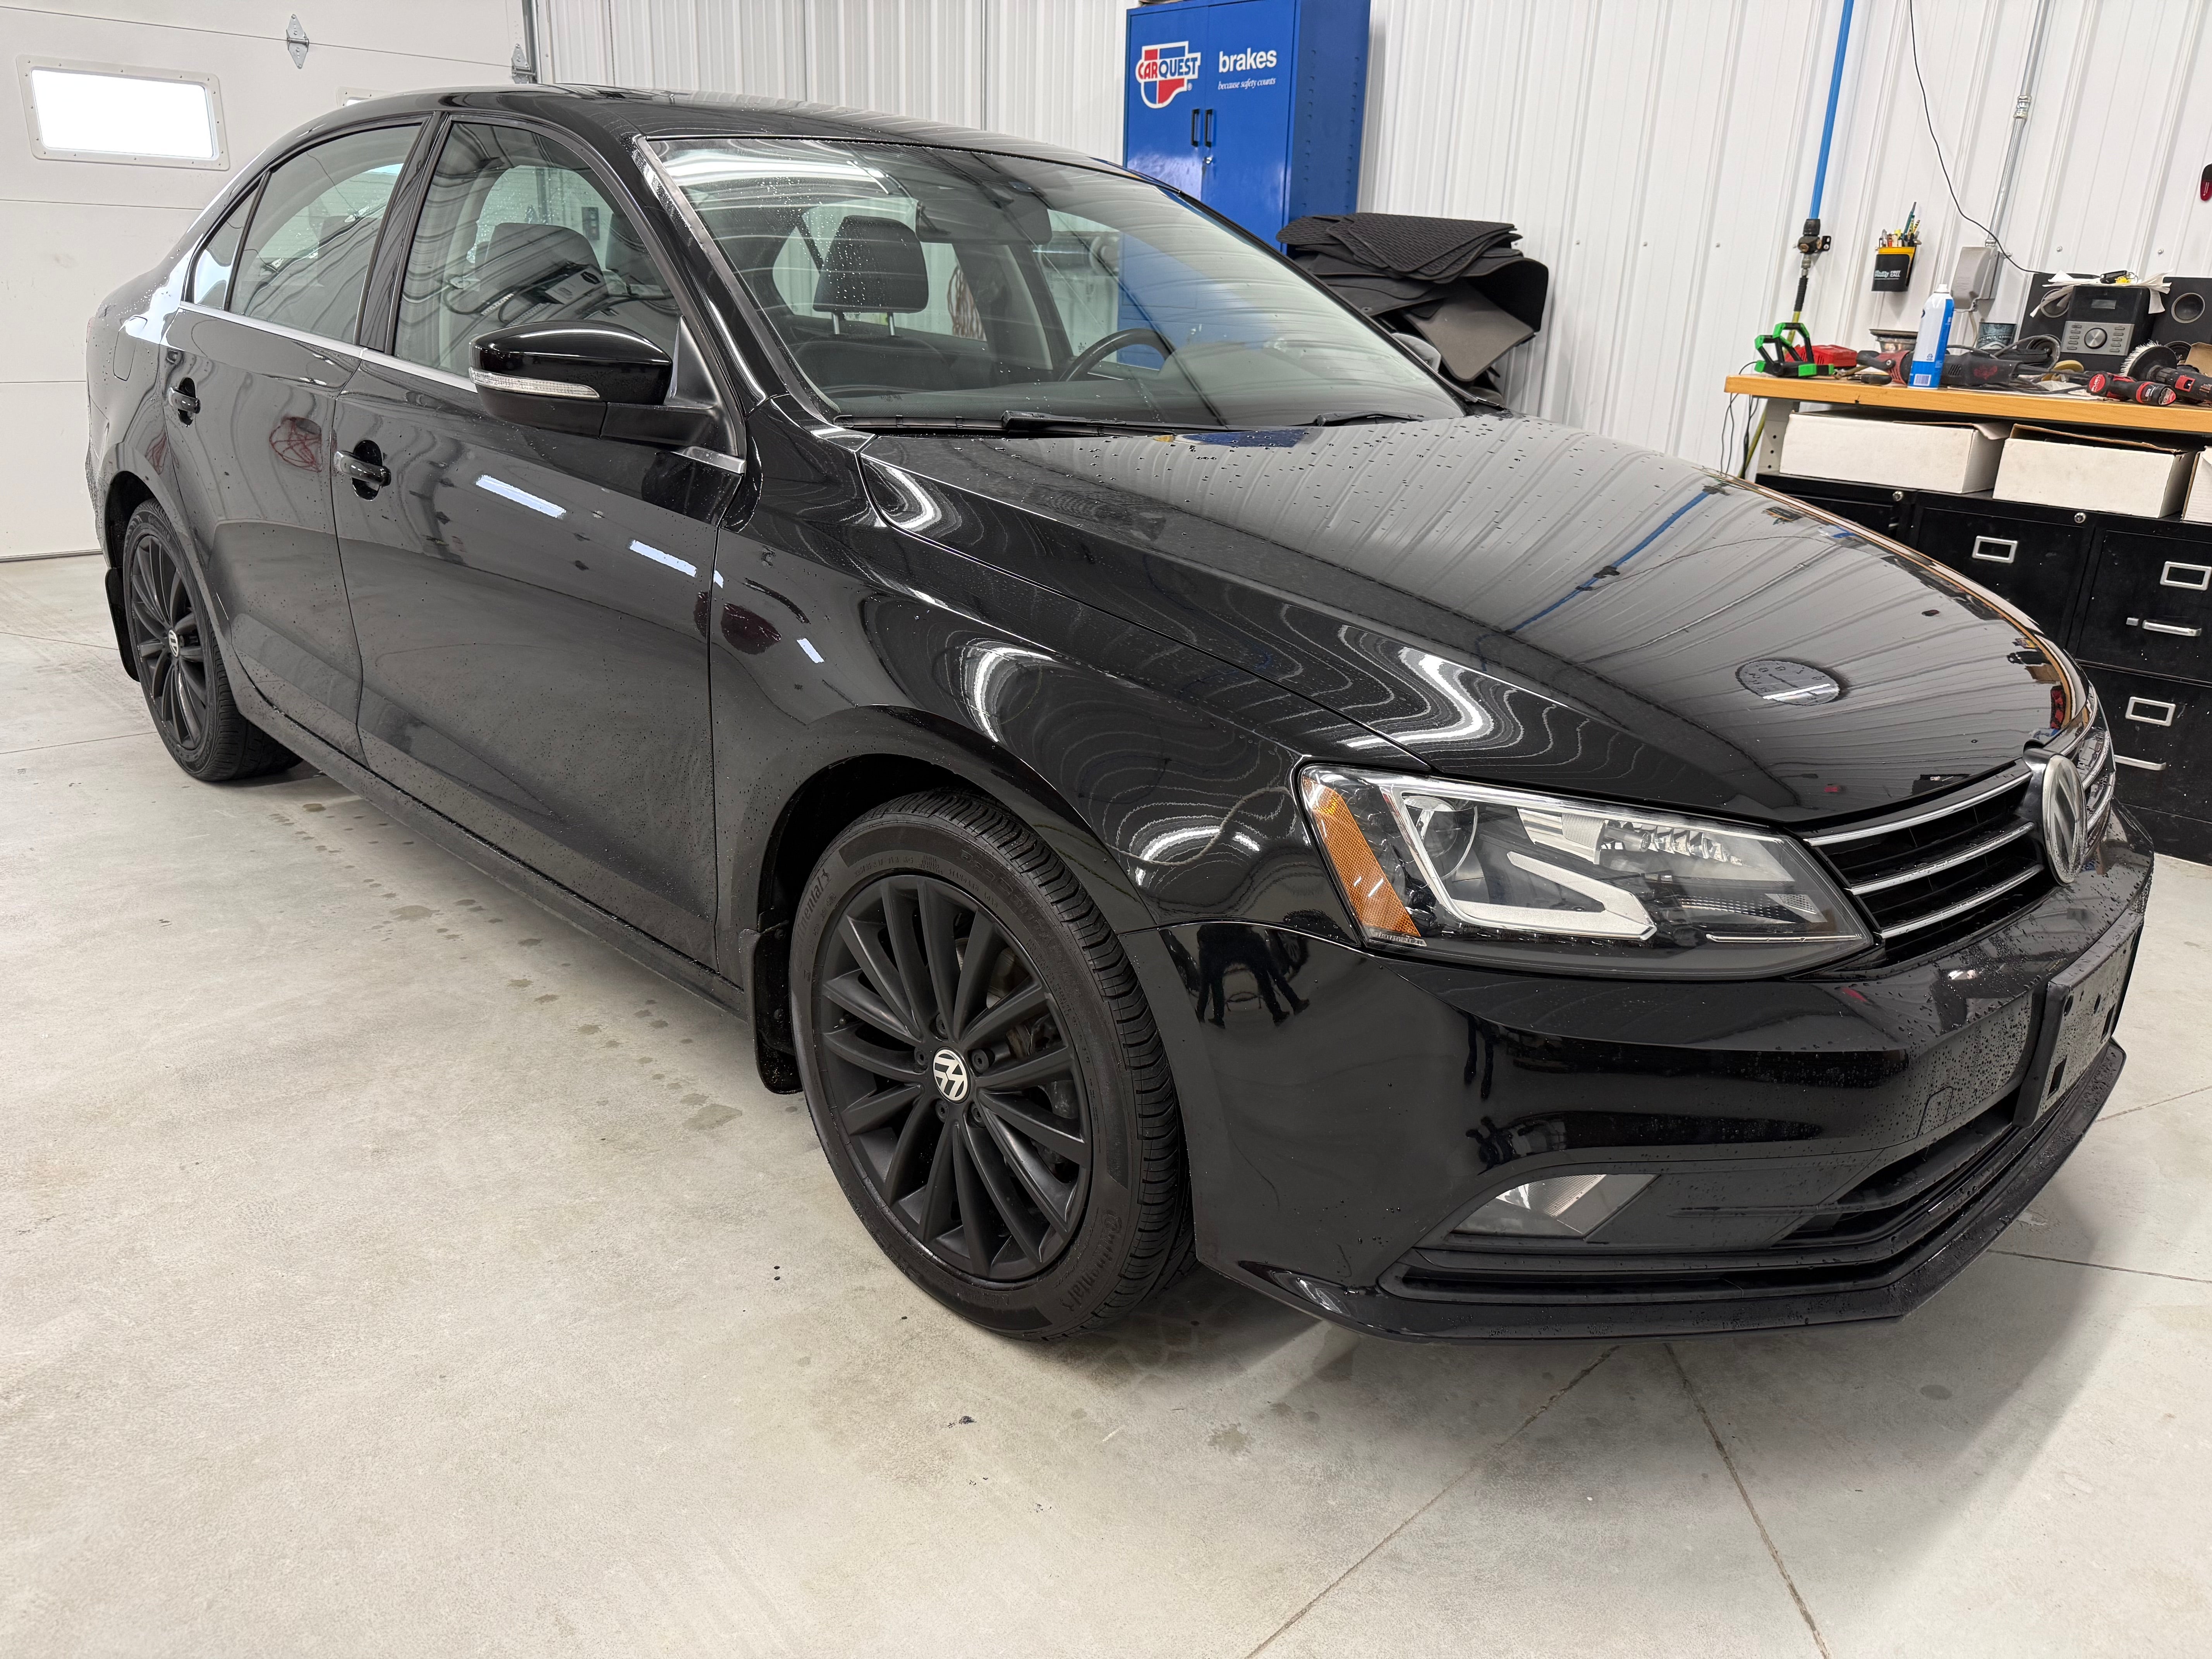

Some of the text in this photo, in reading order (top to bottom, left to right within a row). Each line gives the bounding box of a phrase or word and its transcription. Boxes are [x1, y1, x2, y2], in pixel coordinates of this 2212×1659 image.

[1138, 57, 1198, 79] CARQUEST
[1218, 47, 1277, 73] brakes
[1218, 77, 1276, 90] because safety counts
[2091, 374, 2100, 392] FUEL
